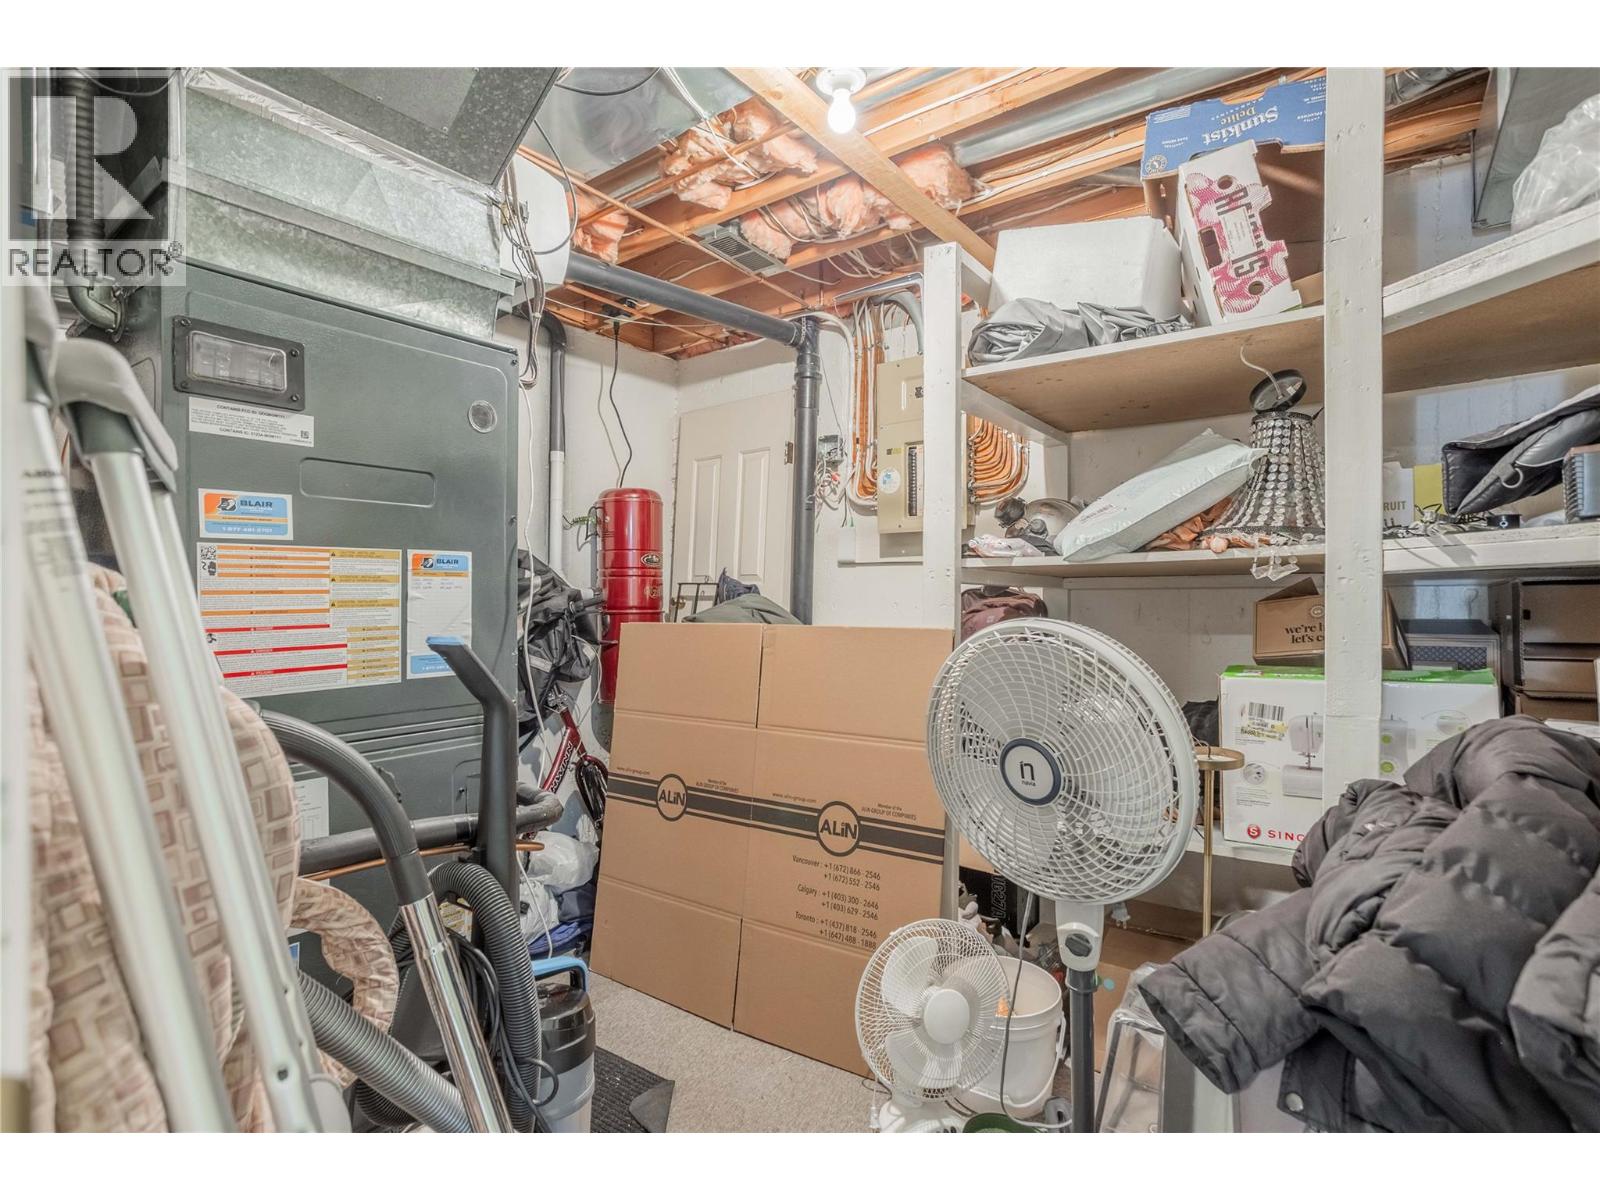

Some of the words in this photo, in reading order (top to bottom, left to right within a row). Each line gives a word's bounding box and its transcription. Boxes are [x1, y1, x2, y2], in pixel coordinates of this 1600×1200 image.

[1202, 106, 1279, 145] Sunkist
[1285, 624, 1316, 634] we're
[1292, 634, 1314, 644] let's
[793, 855, 819, 867] Vancouver
[865, 870, 880, 880] 2546
[864, 880, 880, 891] 2546
[862, 910, 878, 920] 2546
[796, 911, 816, 923] Toronto
[861, 928, 877, 938] 2546
